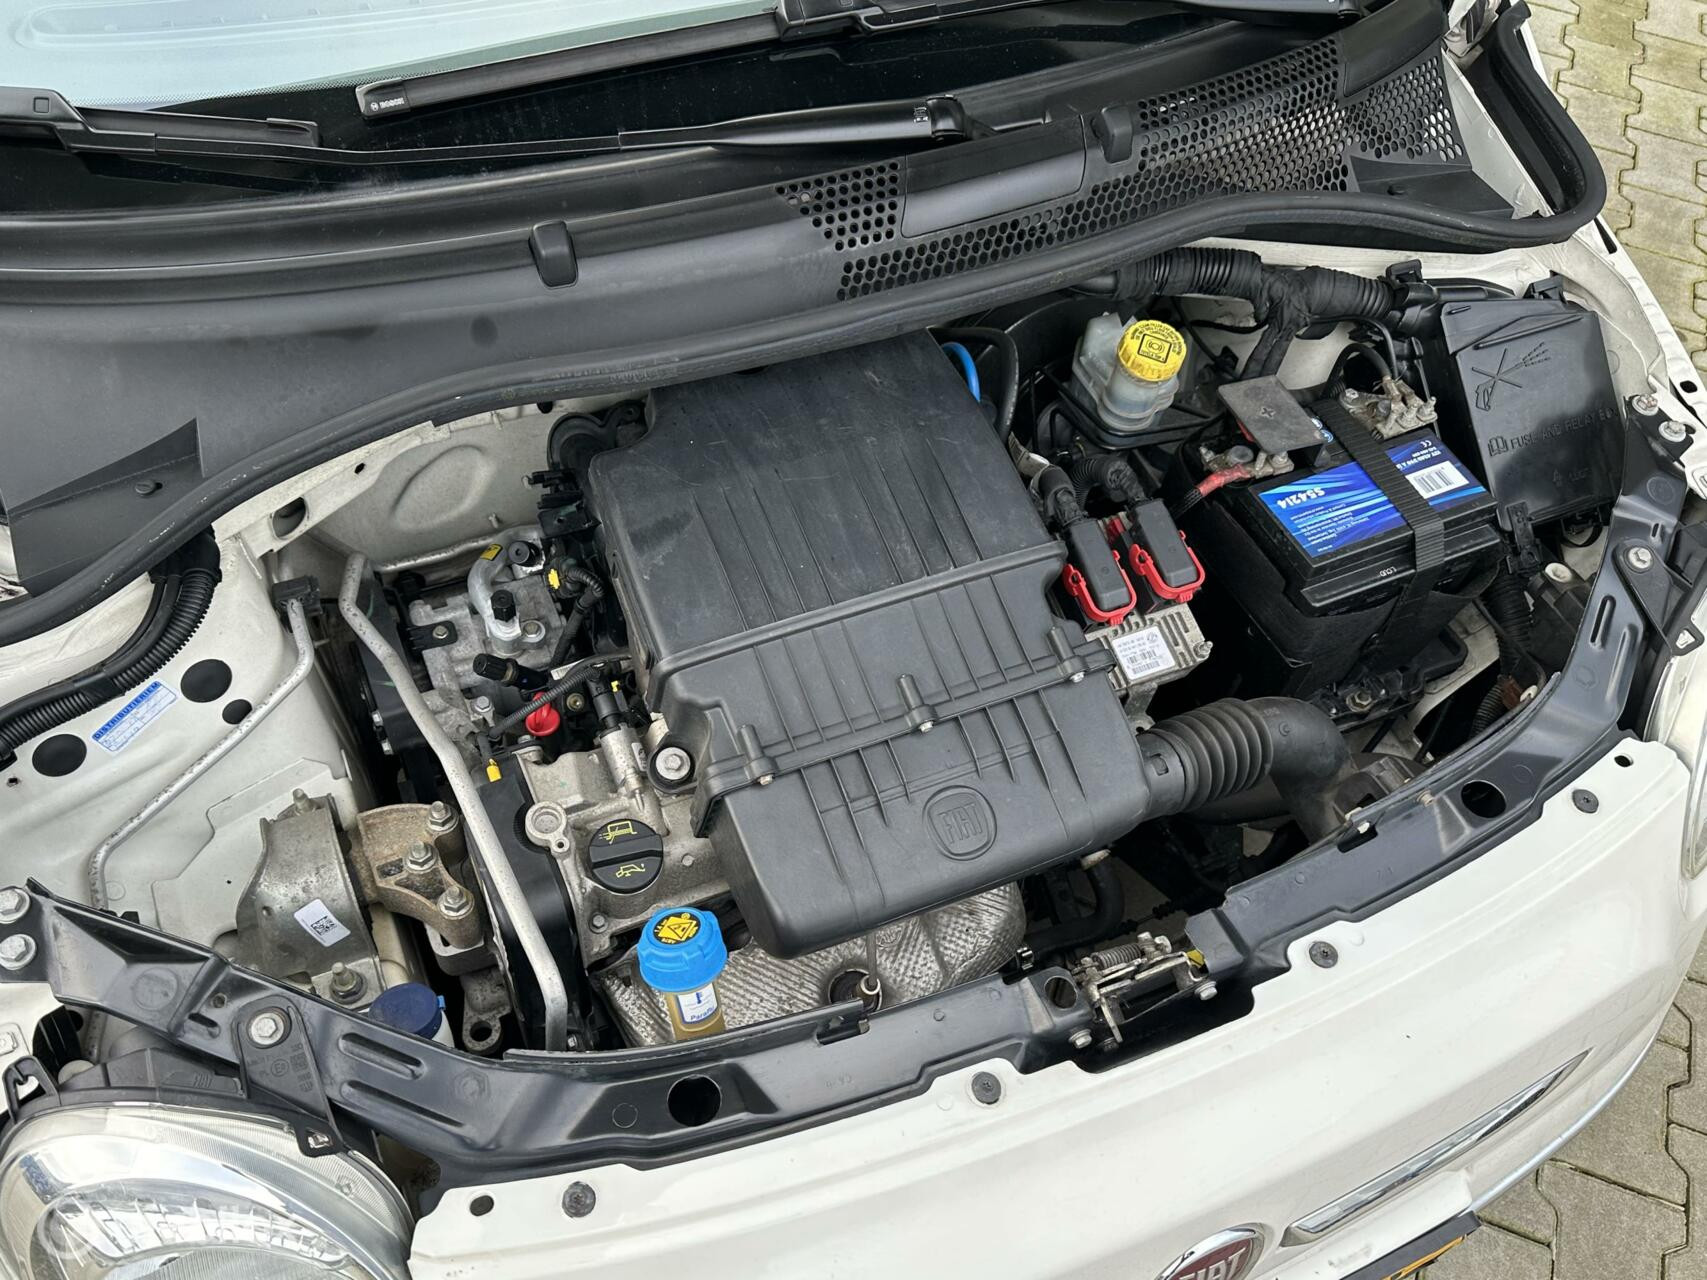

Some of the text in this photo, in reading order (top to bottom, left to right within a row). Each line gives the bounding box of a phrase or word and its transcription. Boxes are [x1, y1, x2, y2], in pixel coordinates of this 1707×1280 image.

[379, 97, 405, 109] BOSCH
[1510, 432, 1538, 450] FUSE
[937, 801, 984, 845] FIAT
[1179, 1247, 1247, 1280] AT
